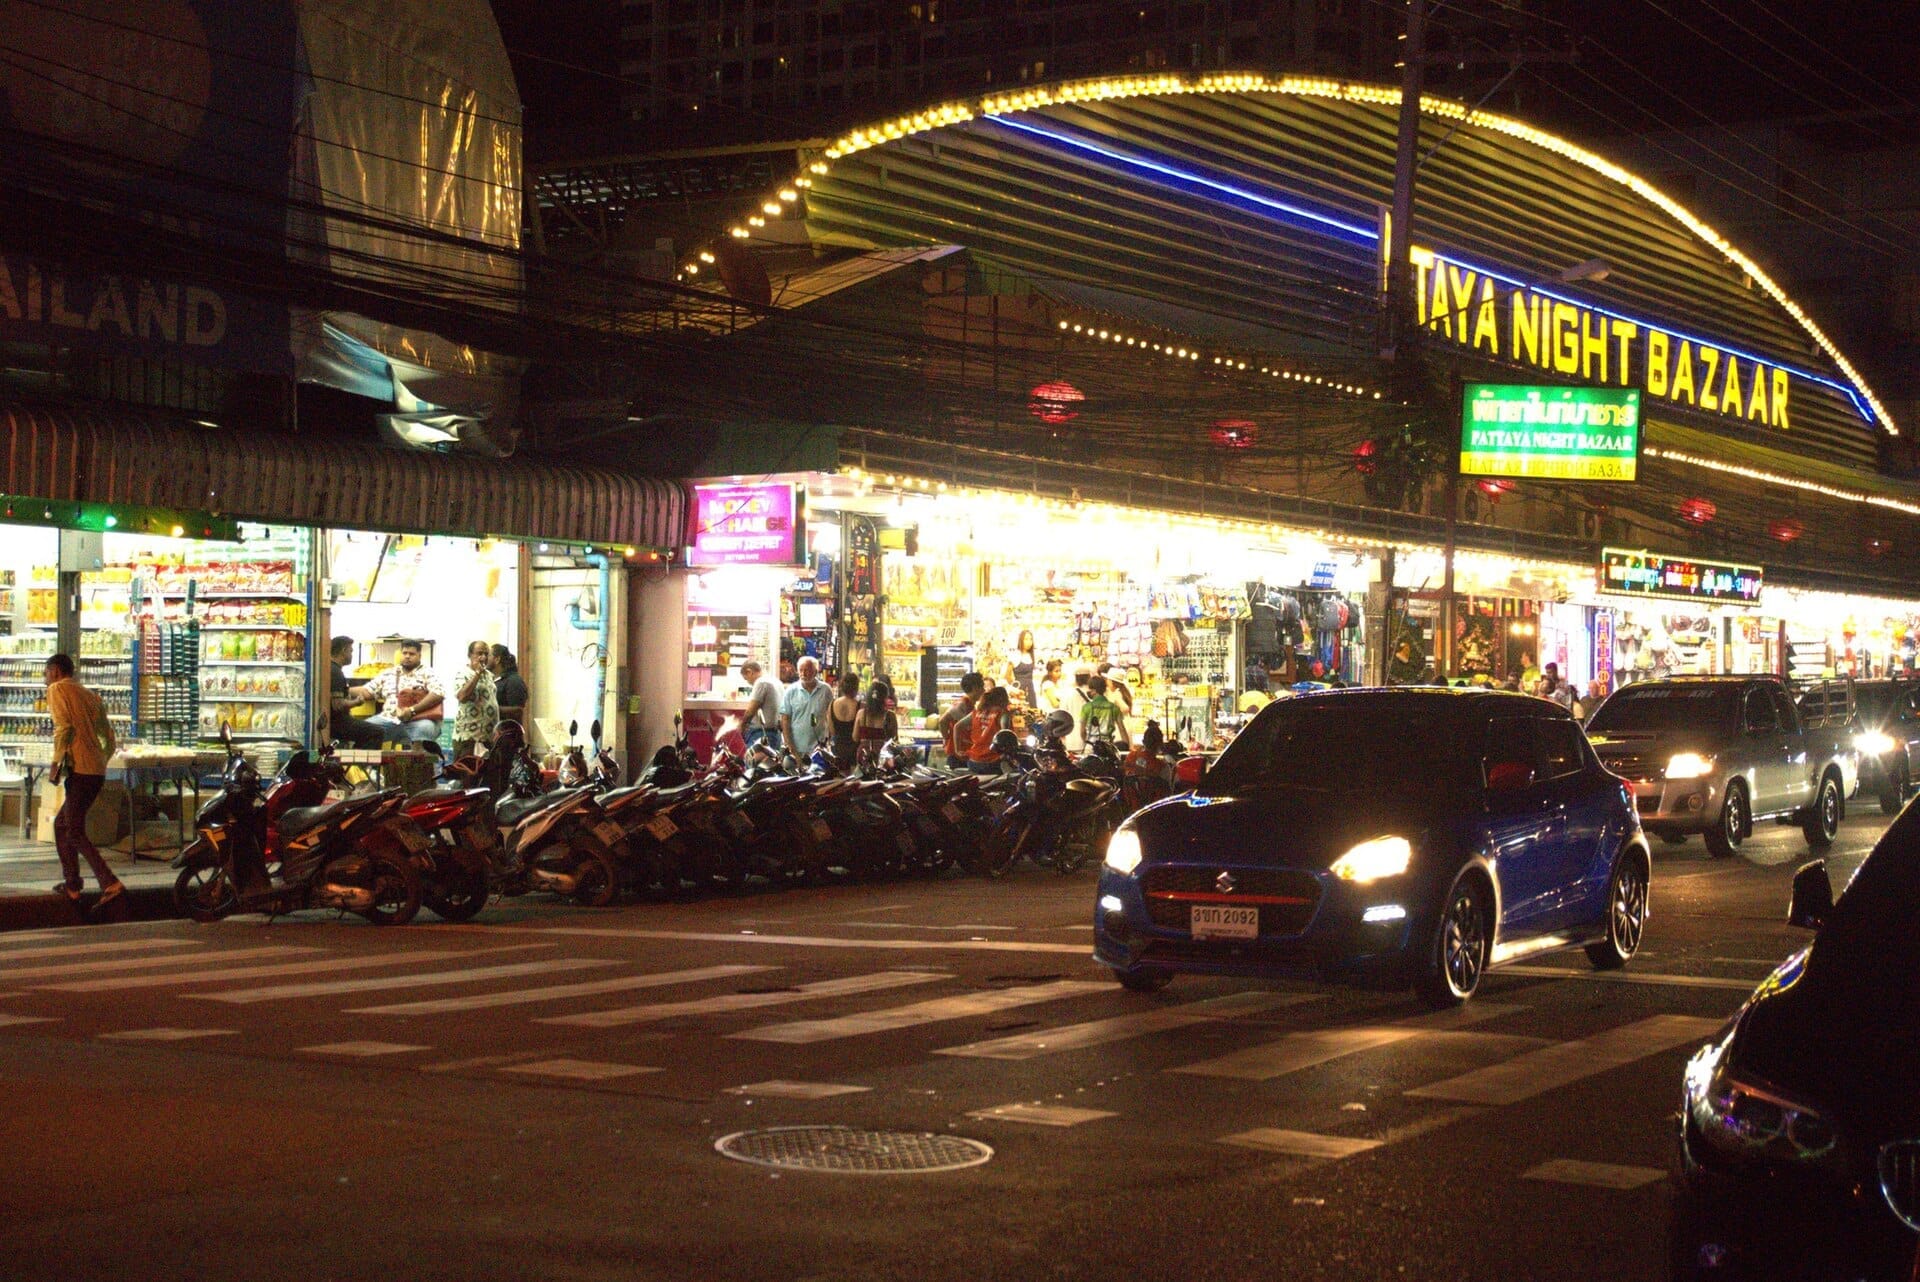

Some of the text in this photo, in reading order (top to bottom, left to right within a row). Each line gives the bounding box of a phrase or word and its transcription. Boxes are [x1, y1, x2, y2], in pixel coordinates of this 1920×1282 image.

[1513, 289, 1637, 386] NIGHT
[1648, 330, 1790, 429] BAZAAR
[1471, 430, 1633, 450] PATTAYA NIGHT BAZAAR
[1588, 462, 1633, 478] БАЗАР
[709, 498, 771, 515] MONEY
[941, 627, 956, 639] 100
[1224, 911, 1256, 925] 2092
